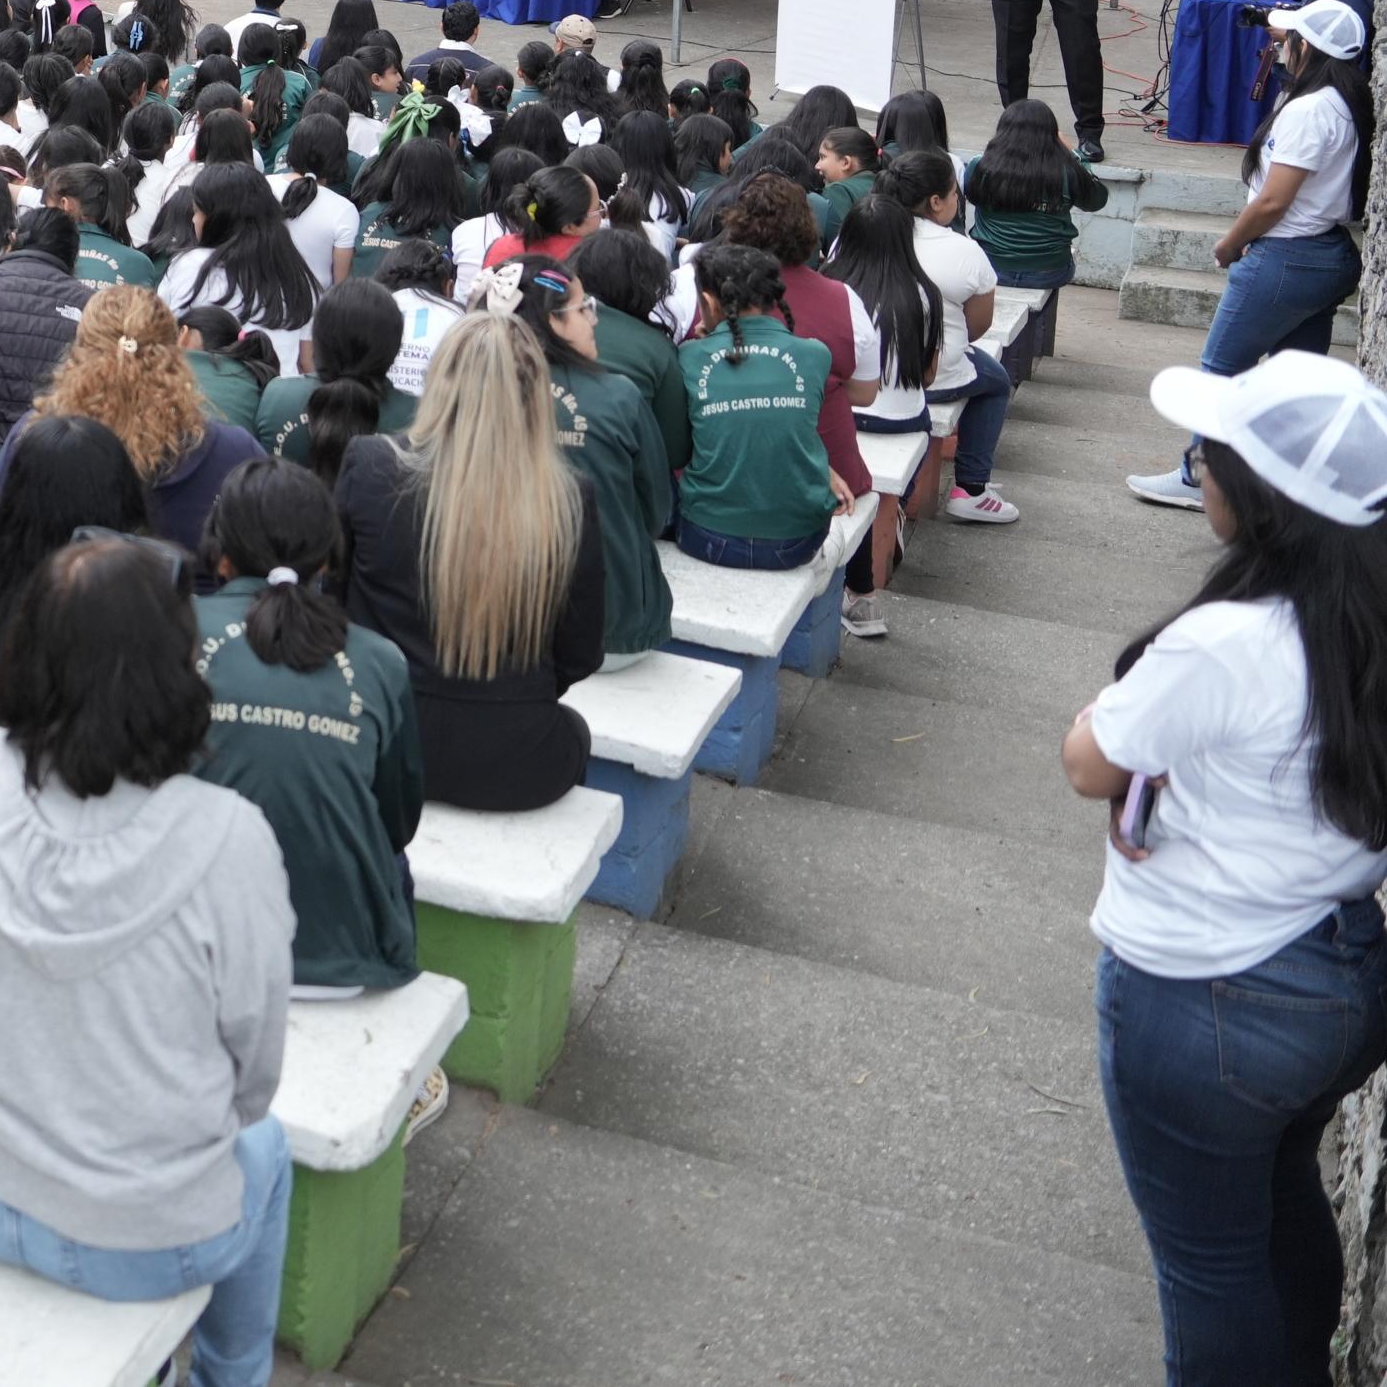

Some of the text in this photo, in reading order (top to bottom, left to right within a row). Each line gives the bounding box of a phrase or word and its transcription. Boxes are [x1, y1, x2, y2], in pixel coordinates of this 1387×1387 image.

[380, 239, 402, 249] CAST
[795, 375, 804, 392] 49
[701, 396, 806, 416] JESUS CASTRO GOMEZ
[557, 430, 585, 447] OMEZ
[240, 703, 305, 731] CASTRO
[308, 714, 361, 745] GOMEZ
